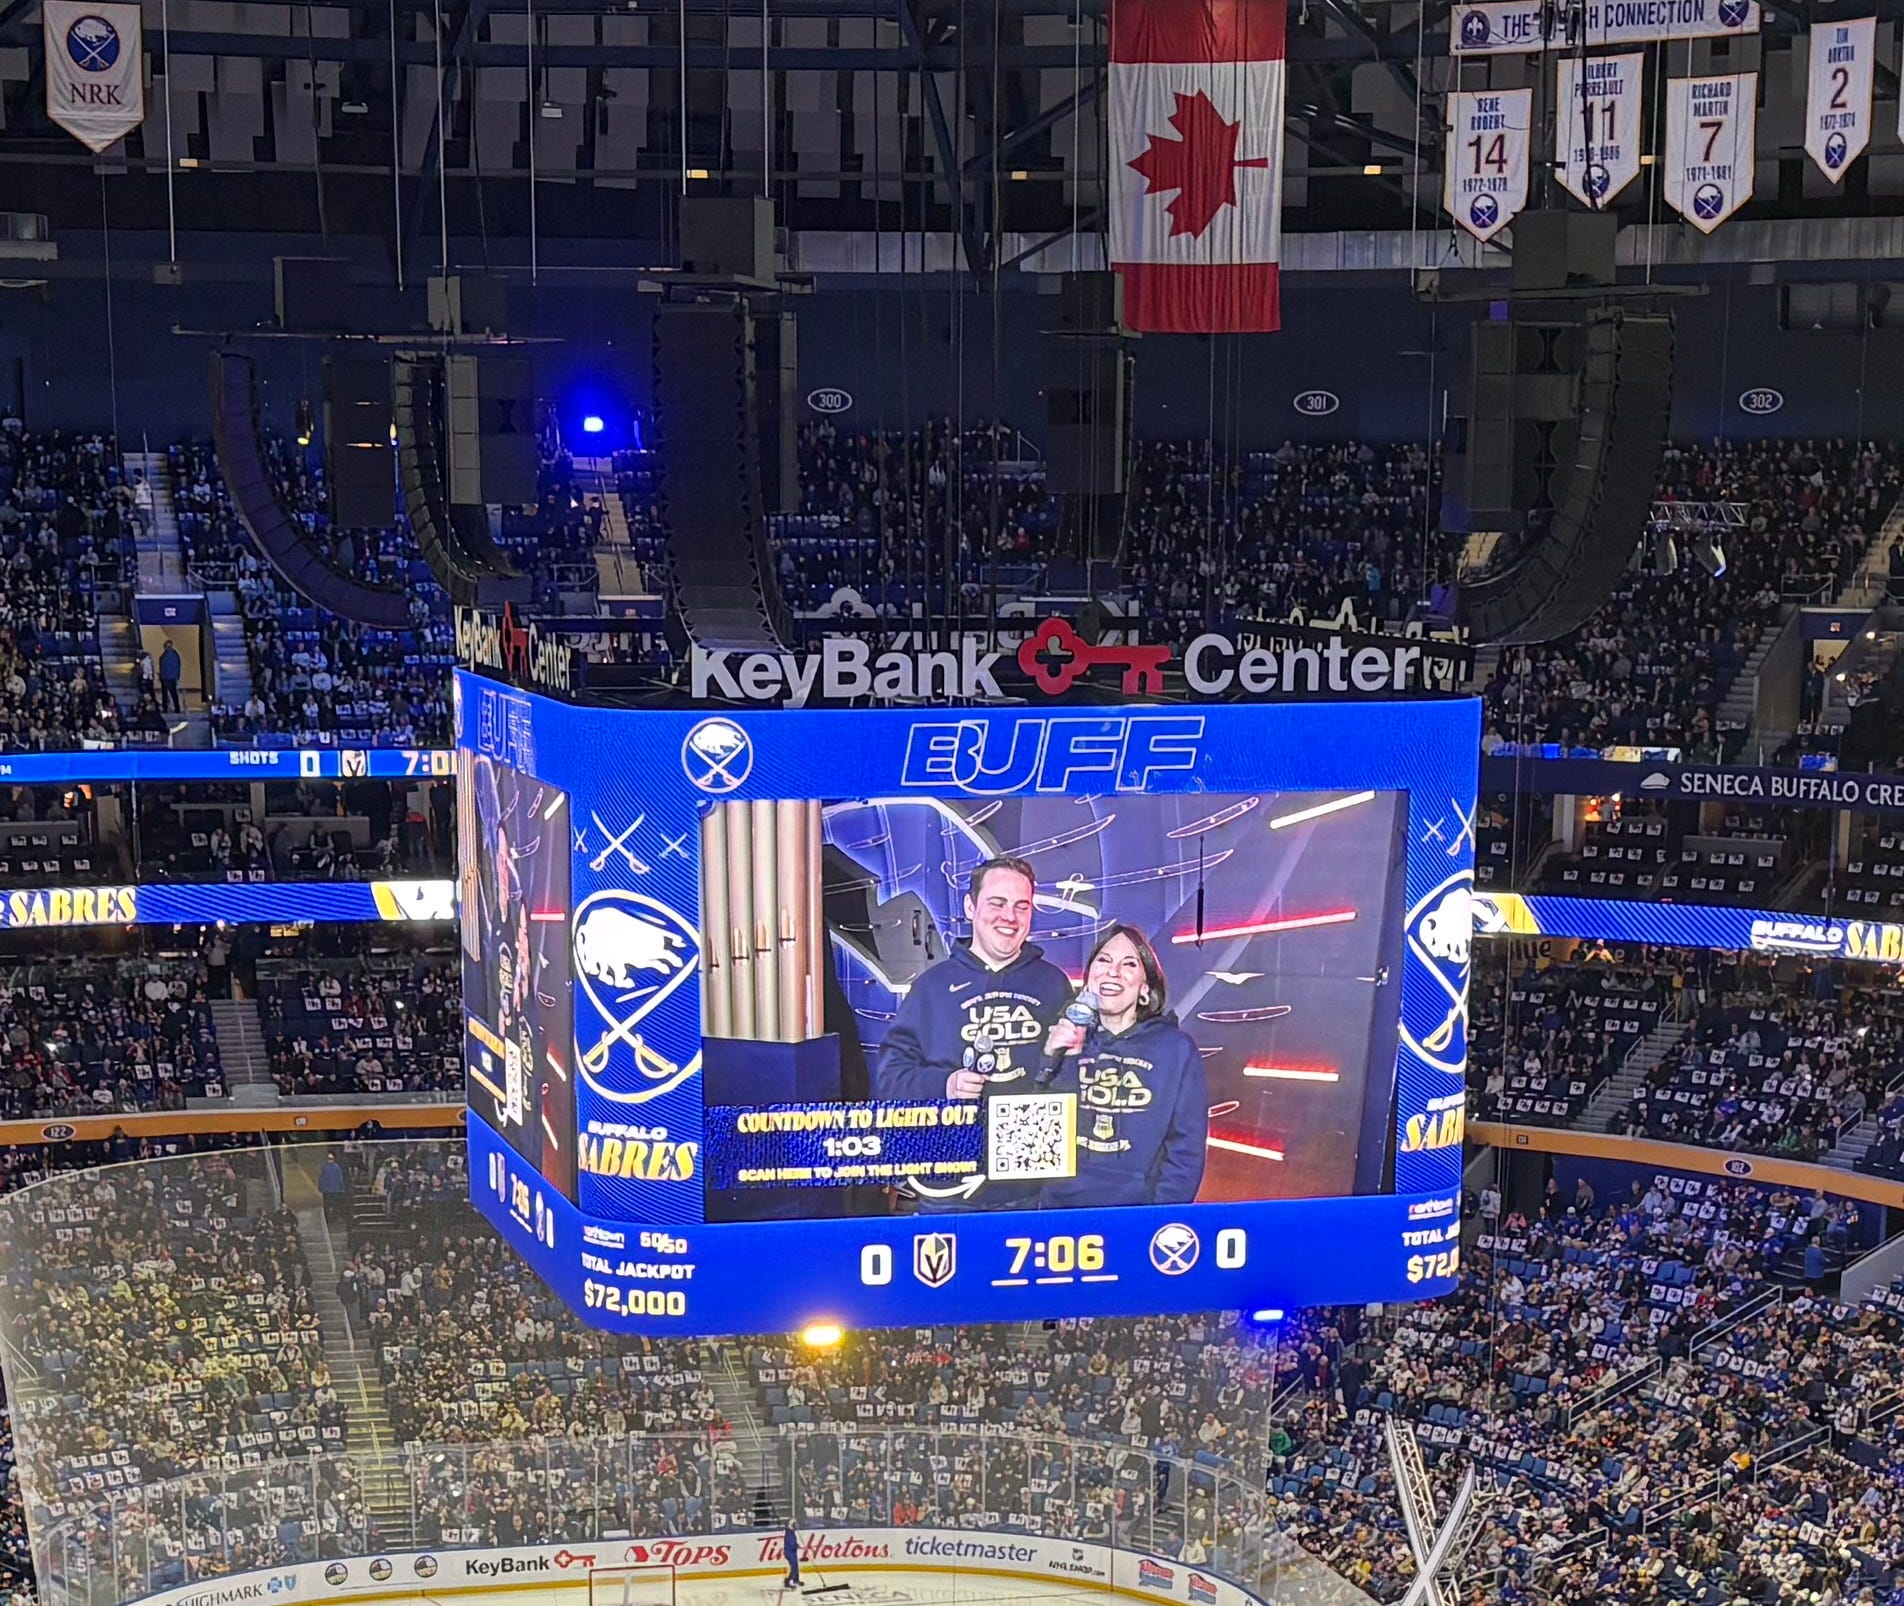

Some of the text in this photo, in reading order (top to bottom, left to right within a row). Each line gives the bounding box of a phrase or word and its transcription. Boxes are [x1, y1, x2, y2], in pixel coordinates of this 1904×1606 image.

[1501, 13, 1530, 38] THE
[1604, 0, 1704, 27] CONNECTION
[70, 82, 121, 105] NRK
[1831, 67, 1849, 109] 2
[1468, 134, 1507, 174] 14
[1700, 121, 1723, 162] 7
[819, 394, 842, 408] 300
[1306, 395, 1327, 410] 301
[1749, 394, 1773, 408] 302
[529, 621, 572, 691] Center
[691, 633, 1420, 707] KeyBank Center
[229, 751, 279, 765] SHOTS
[300, 750, 319, 777] 0
[1680, 772, 1764, 797] SENECA
[1771, 777, 1860, 803] BUFFALO
[8, 886, 137, 926] SABRES
[1751, 919, 1843, 941] BUFFALO
[970, 1005, 1035, 1024] USA
[960, 1020, 1042, 1042] GOLD
[1079, 1067, 1143, 1089] USA
[587, 1119, 668, 1140] BUFFALO
[737, 1105, 979, 1133] COUNTDOWN TO LIGHTS OUT
[578, 1132, 698, 1181] SABRES
[823, 1136, 882, 1157] 1:03
[738, 1169, 775, 1181] SCAN
[776, 1168, 812, 1180] HERE
[815, 1167, 833, 1179] TO
[836, 1166, 866, 1178] JOIN
[869, 1165, 892, 1176] THE
[894, 1163, 932, 1175] LIGHT
[1402, 1228, 1444, 1246] TOTAL
[860, 1227, 1248, 1287] 0 7:06 0
[615, 1261, 696, 1280] JACKPOT
[584, 1278, 687, 1317] $72,000
[798, 1532, 890, 1562] Hortons
[905, 1536, 1037, 1563] ticketmaster
[466, 1556, 551, 1578] KeyBank
